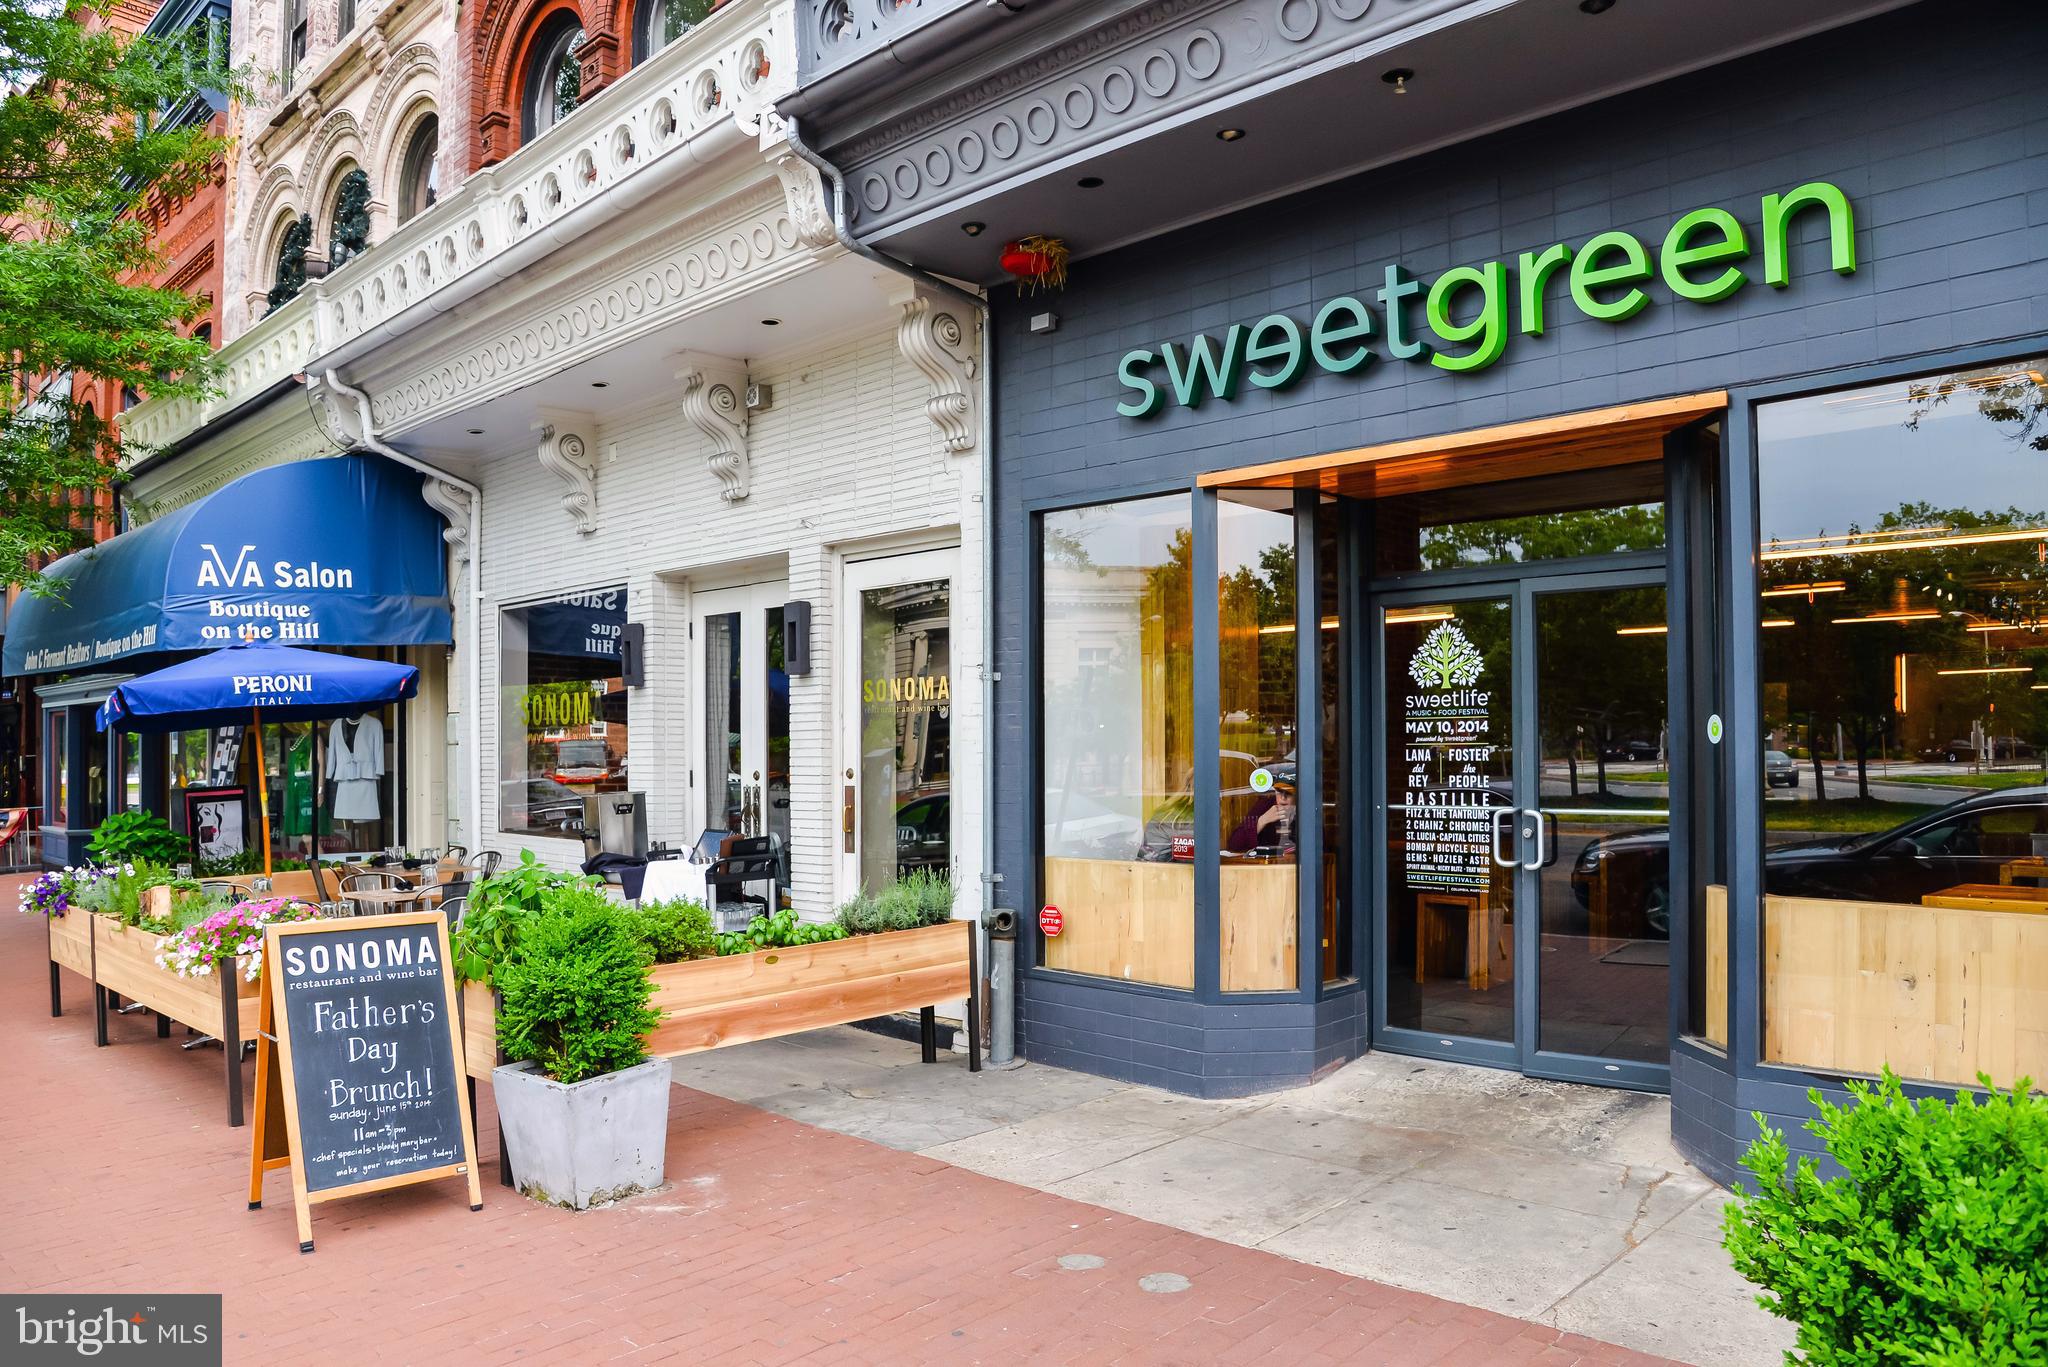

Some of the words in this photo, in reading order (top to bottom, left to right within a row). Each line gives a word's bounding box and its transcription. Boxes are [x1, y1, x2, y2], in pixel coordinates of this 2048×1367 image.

[1115, 181, 1857, 419] sweetgreen
[197, 544, 265, 588] AVA
[274, 561, 353, 588] Salon
[209, 600, 311, 621] Boutique
[201, 625, 231, 639] on
[237, 622, 273, 639] the
[278, 622, 320, 639] Hill
[25, 651, 38, 671] John
[38, 649, 43, 669] C
[43, 645, 66, 668] Formant
[66, 641, 91, 665] Realtors
[95, 638, 121, 659] Boutique
[122, 637, 130, 652] on
[131, 629, 142, 650] the
[142, 623, 157, 647] Hill
[232, 674, 313, 695] PERONI
[863, 675, 950, 703] SONOMA
[254, 696, 292, 706] ITALY
[1405, 689, 1488, 708] sweetlife
[901, 703, 915, 713] and
[917, 703, 935, 712] wine
[1405, 721, 1434, 733] MAY
[1436, 721, 1454, 735] 10,
[1457, 720, 1489, 733] 2014
[1405, 748, 1431, 761] LANA
[1448, 748, 1489, 761] FOSTER
[1412, 763, 1425, 773] del
[1463, 763, 1476, 773] the
[1408, 774, 1429, 788] REY
[1448, 774, 1490, 788] PEOPLE
[1405, 792, 1490, 807] BASTILLE
[1406, 808, 1422, 818] FITZ
[1424, 808, 1430, 818] &
[1432, 808, 1447, 819] THE
[1449, 809, 1490, 819] TANTRUMS
[1406, 820, 1411, 830] 2
[1413, 820, 1444, 831] CHAINZ
[1449, 821, 1490, 832] CHROMEO
[1406, 831, 1415, 840] ST.
[1417, 832, 1436, 841] LUCIA
[1439, 832, 1466, 842] CAPITAL
[1468, 833, 1490, 843] CITIES
[1173, 845, 1188, 853] 2013
[1406, 842, 1435, 852] BOMBAY
[1437, 843, 1468, 853] BICYCLE
[1470, 844, 1490, 854] CLUB
[1406, 853, 1427, 862] GEMS
[1433, 854, 1463, 864] HOZIER
[1469, 856, 1490, 865] ASTR
[1406, 874, 1490, 884] SWEETLIFEFESTIVAL.COM
[286, 936, 437, 977] SONOMA
[289, 976, 355, 990] restaurant
[359, 971, 383, 983] and
[387, 970, 415, 980] wine
[418, 966, 438, 977] bar
[313, 995, 436, 1034] Father's
[347, 1036, 398, 1074] Day
[329, 1067, 434, 1108] Brunch!
[374, 1102, 397, 1121] june
[414, 1099, 432, 1110] 2014
[337, 1146, 371, 1165] specials
[419, 1136, 432, 1146] bar
[336, 1166, 358, 1177] make
[362, 1162, 381, 1175] your
[386, 1153, 428, 1167] reservation
[432, 1145, 457, 1160] today!
